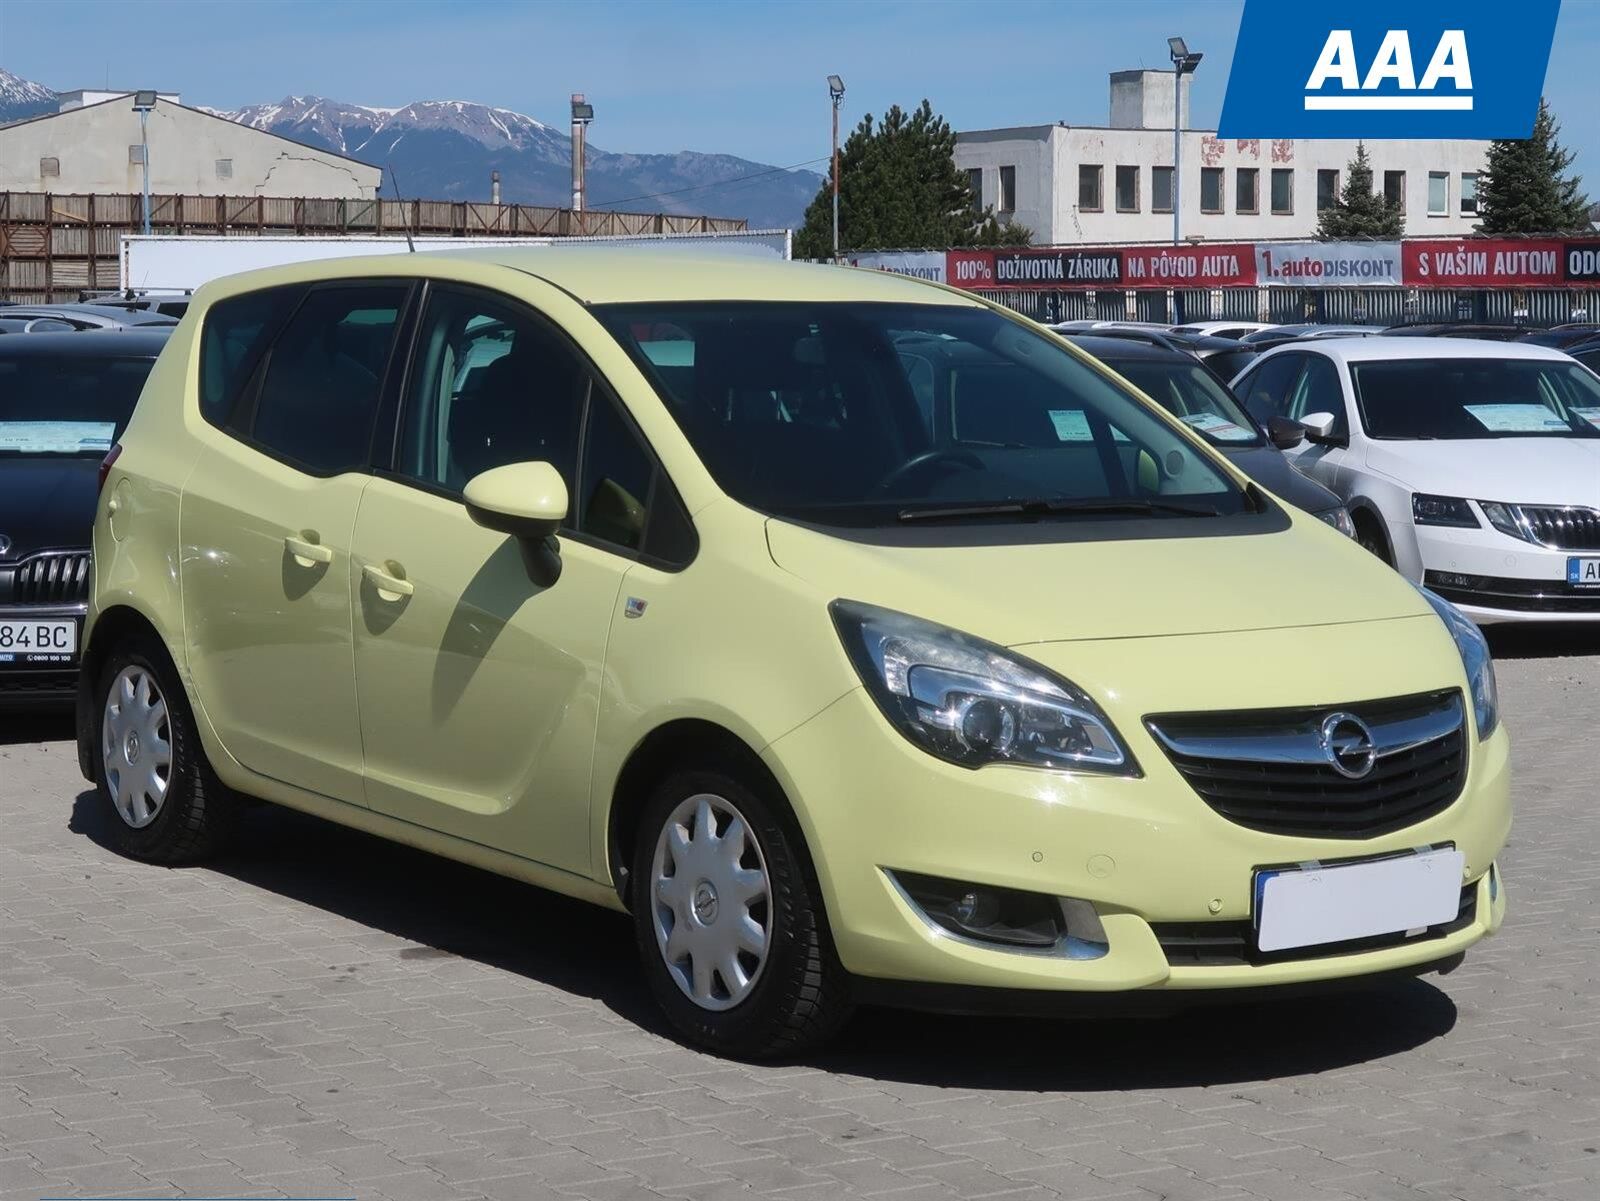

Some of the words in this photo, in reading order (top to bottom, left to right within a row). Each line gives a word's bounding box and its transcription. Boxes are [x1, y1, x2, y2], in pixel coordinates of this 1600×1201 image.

[956, 260, 991, 279] 100%
[997, 253, 1064, 279] DOŽIVOTNÁ
[1068, 253, 1119, 279] ZÁRUKA
[1128, 257, 1146, 278] NA
[1151, 250, 1197, 278] PÔVOD
[1202, 255, 1240, 277] AUTA
[1419, 252, 1430, 276] S
[1435, 245, 1487, 276] VAŠIM
[1493, 251, 1557, 275] AUTOM
[1585, 562, 1600, 579] A
